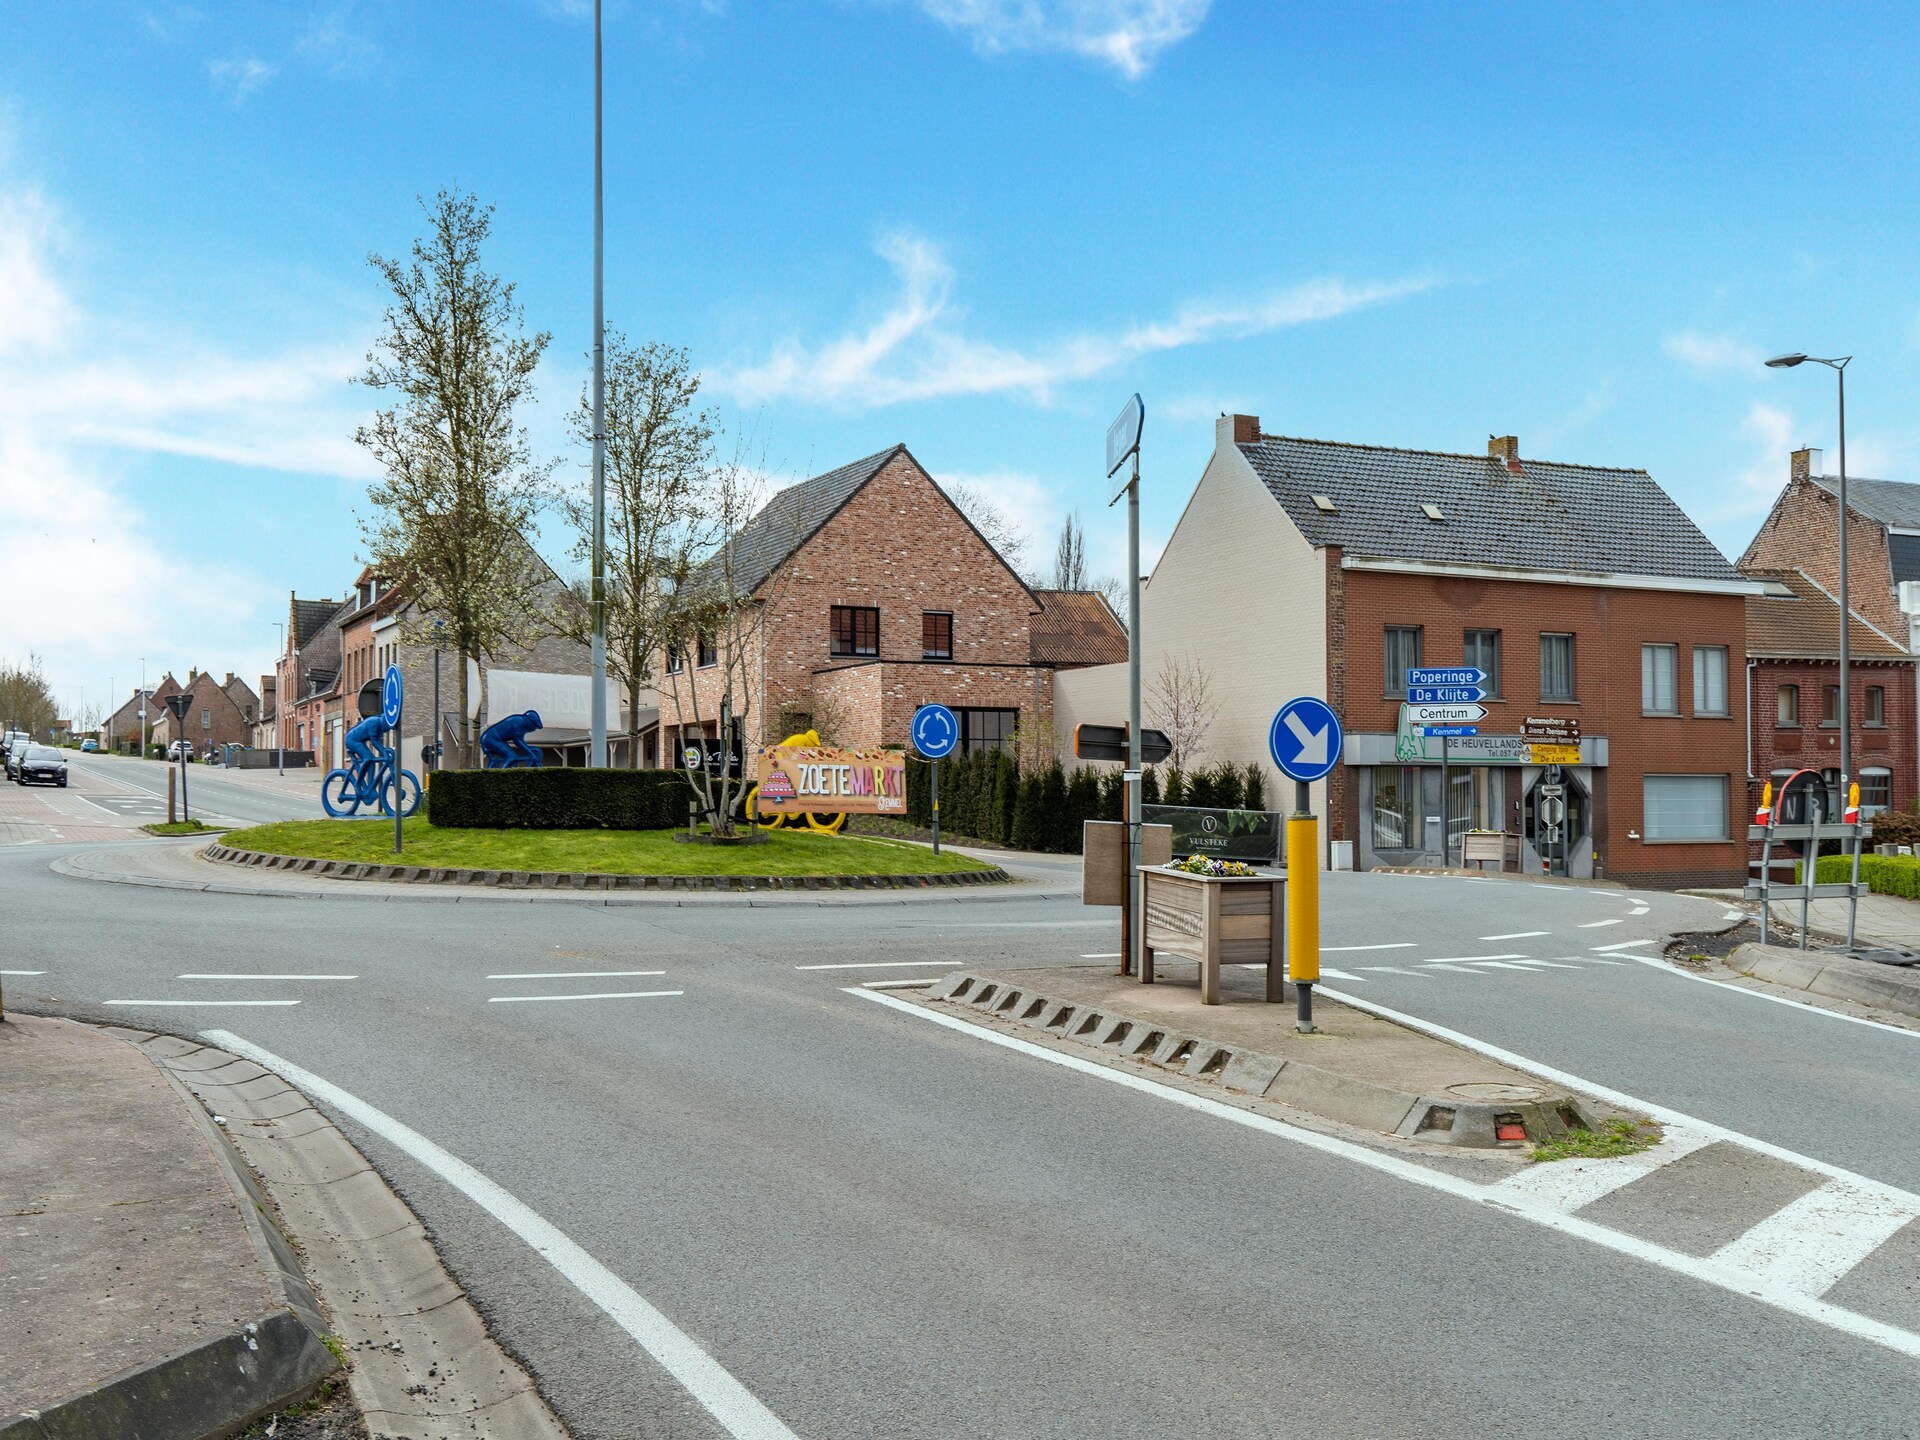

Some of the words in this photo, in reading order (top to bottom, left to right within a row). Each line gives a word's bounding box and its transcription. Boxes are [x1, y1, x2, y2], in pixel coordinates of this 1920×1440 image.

[1412, 671, 1473, 684] Poperinge
[1416, 690, 1432, 701] De
[1437, 689, 1469, 703] Klijte
[1419, 708, 1468, 719] Centrum
[1526, 717, 1566, 727] Kemmelberg
[1447, 738, 1459, 748] DE
[1540, 755, 1550, 763] De
[798, 763, 905, 796] ZOETEMARKT
[1189, 837, 1229, 847] VULSTEKE
